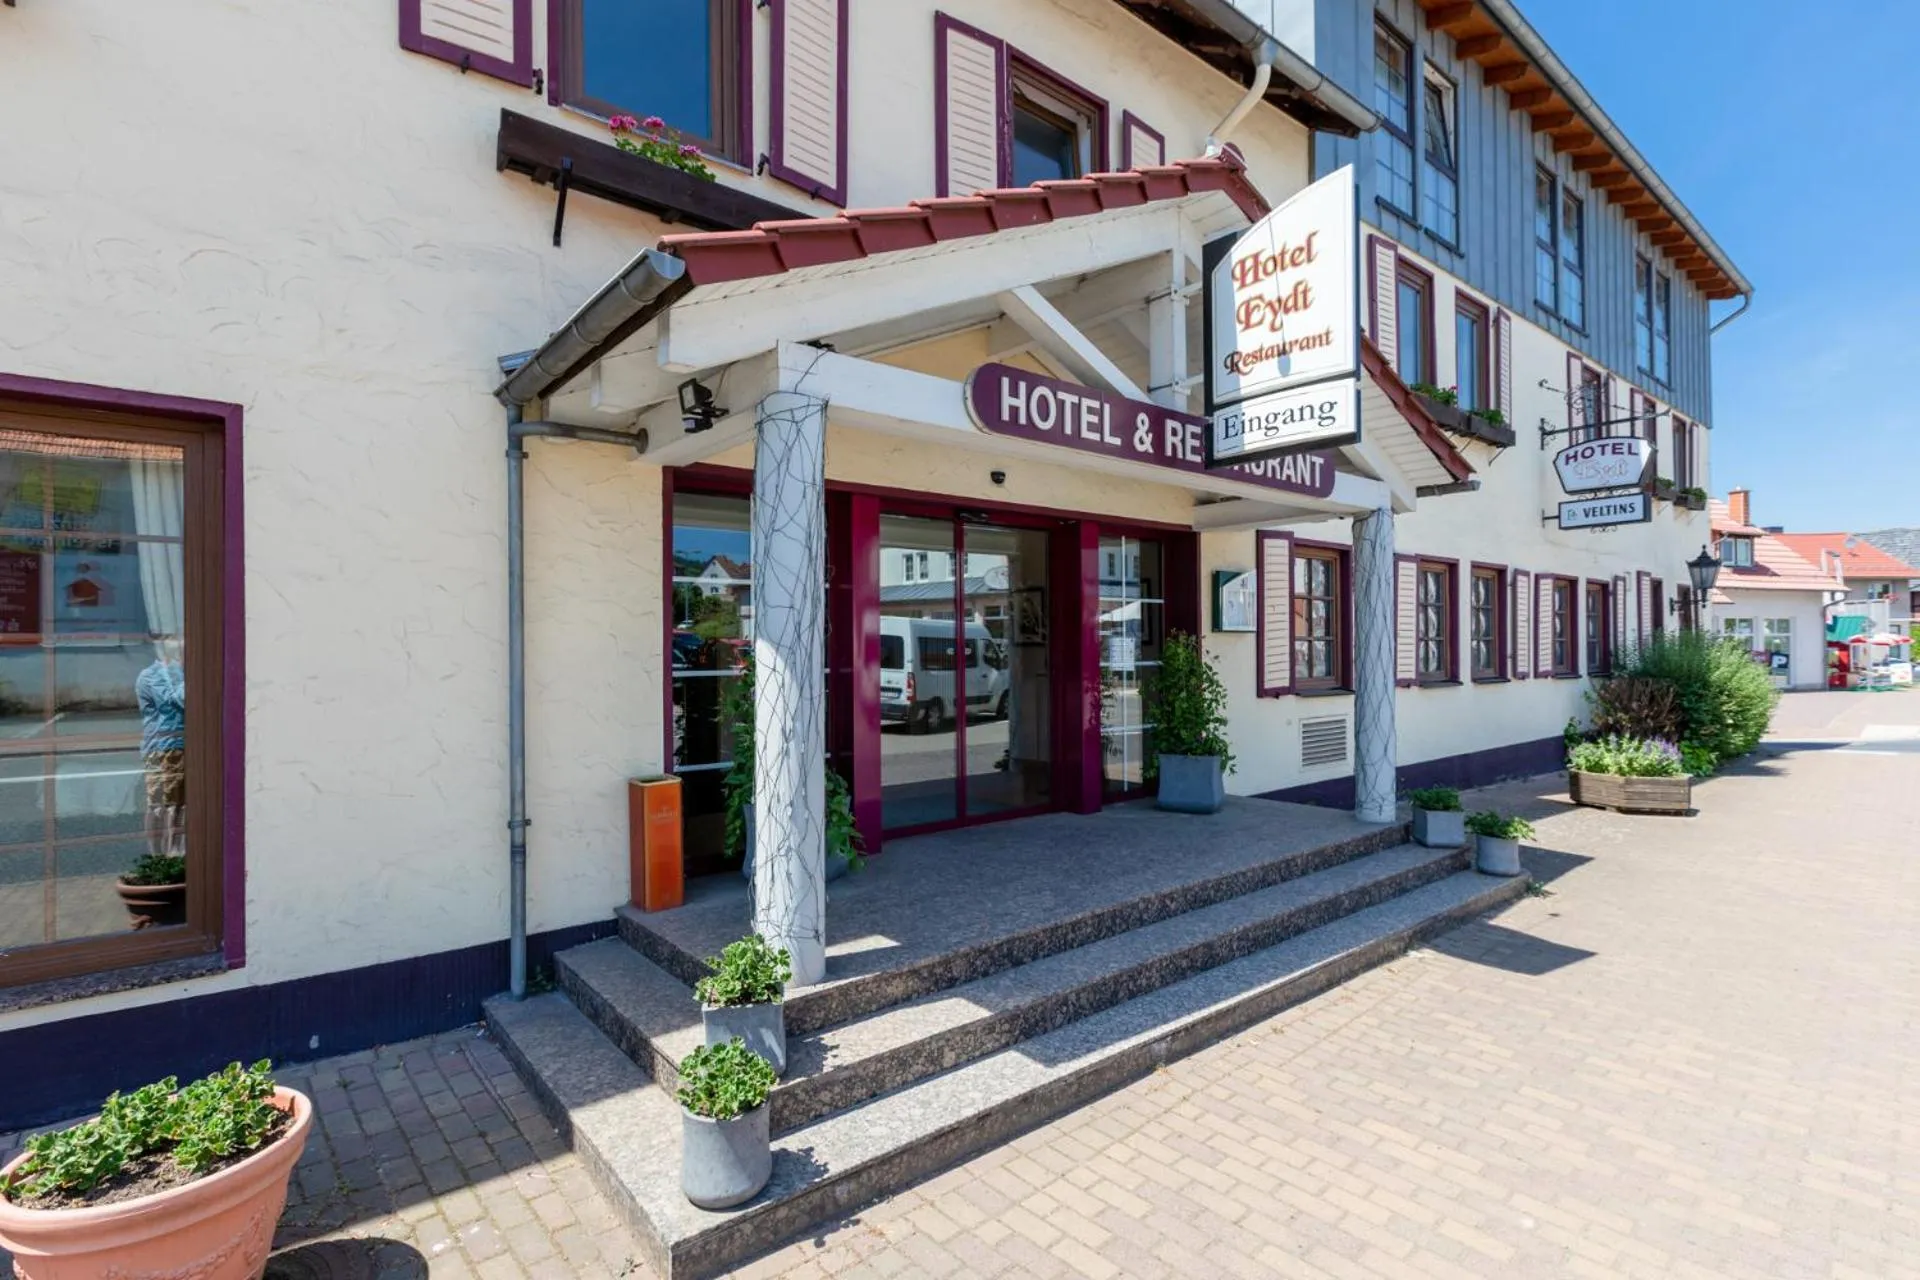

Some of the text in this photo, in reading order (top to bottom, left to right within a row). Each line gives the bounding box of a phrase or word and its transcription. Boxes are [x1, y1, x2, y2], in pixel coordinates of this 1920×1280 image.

[1232, 232, 1319, 290] Hotel
[1237, 279, 1315, 332] Eydt
[1225, 329, 1332, 376] Restaurant
[1000, 376, 1324, 488] HOTEL & REURANT
[1222, 401, 1337, 440] Eingang
[1565, 442, 1639, 465] HOTEL
[1583, 503, 1635, 518] VELTINS
